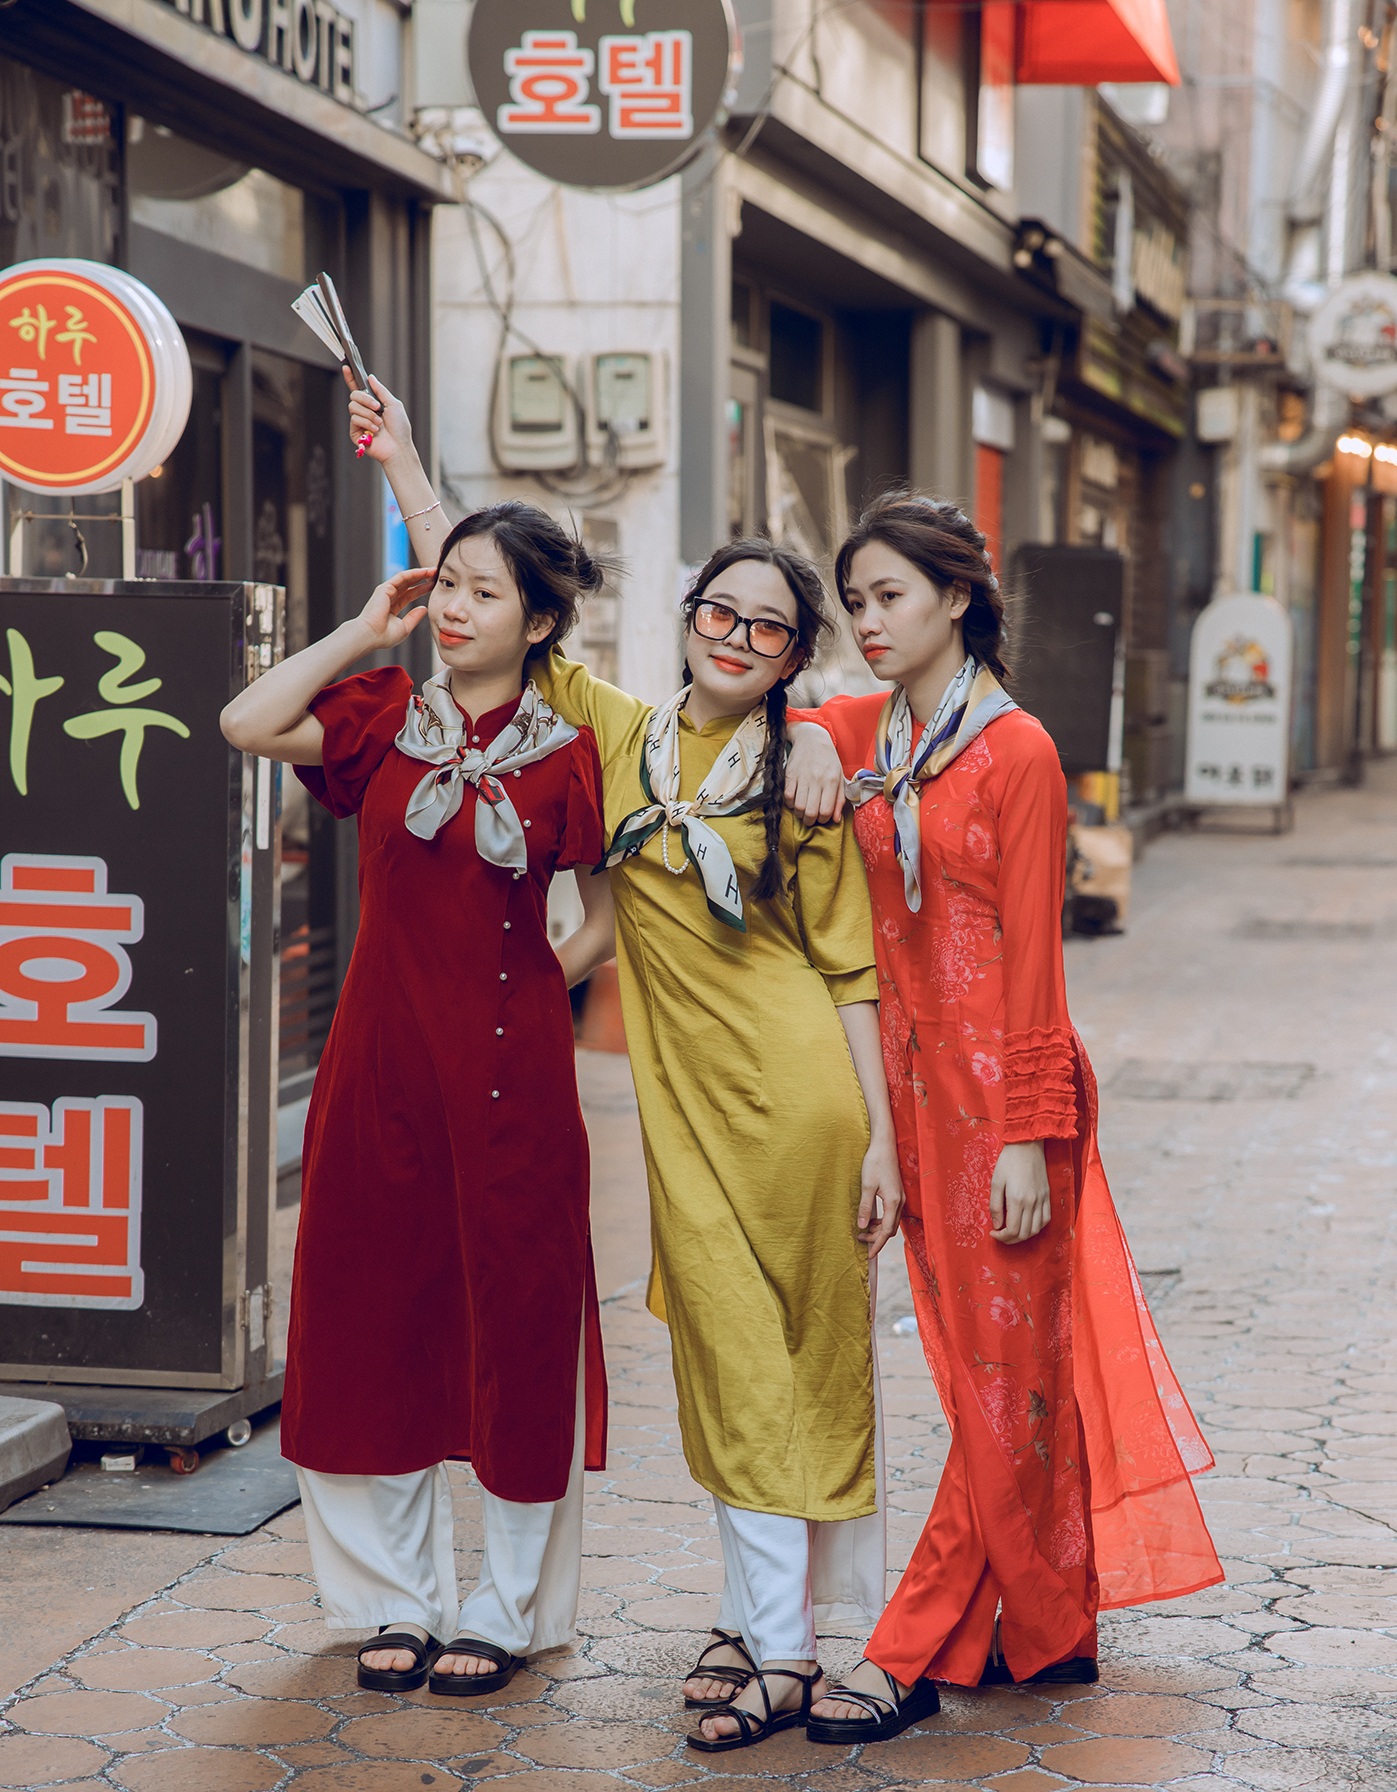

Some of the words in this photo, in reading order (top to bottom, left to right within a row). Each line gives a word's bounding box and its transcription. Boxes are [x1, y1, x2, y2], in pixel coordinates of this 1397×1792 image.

[497, 30, 694, 140] 호텔
[8, 303, 98, 367] 하루
[0, 367, 113, 437] 호텔
